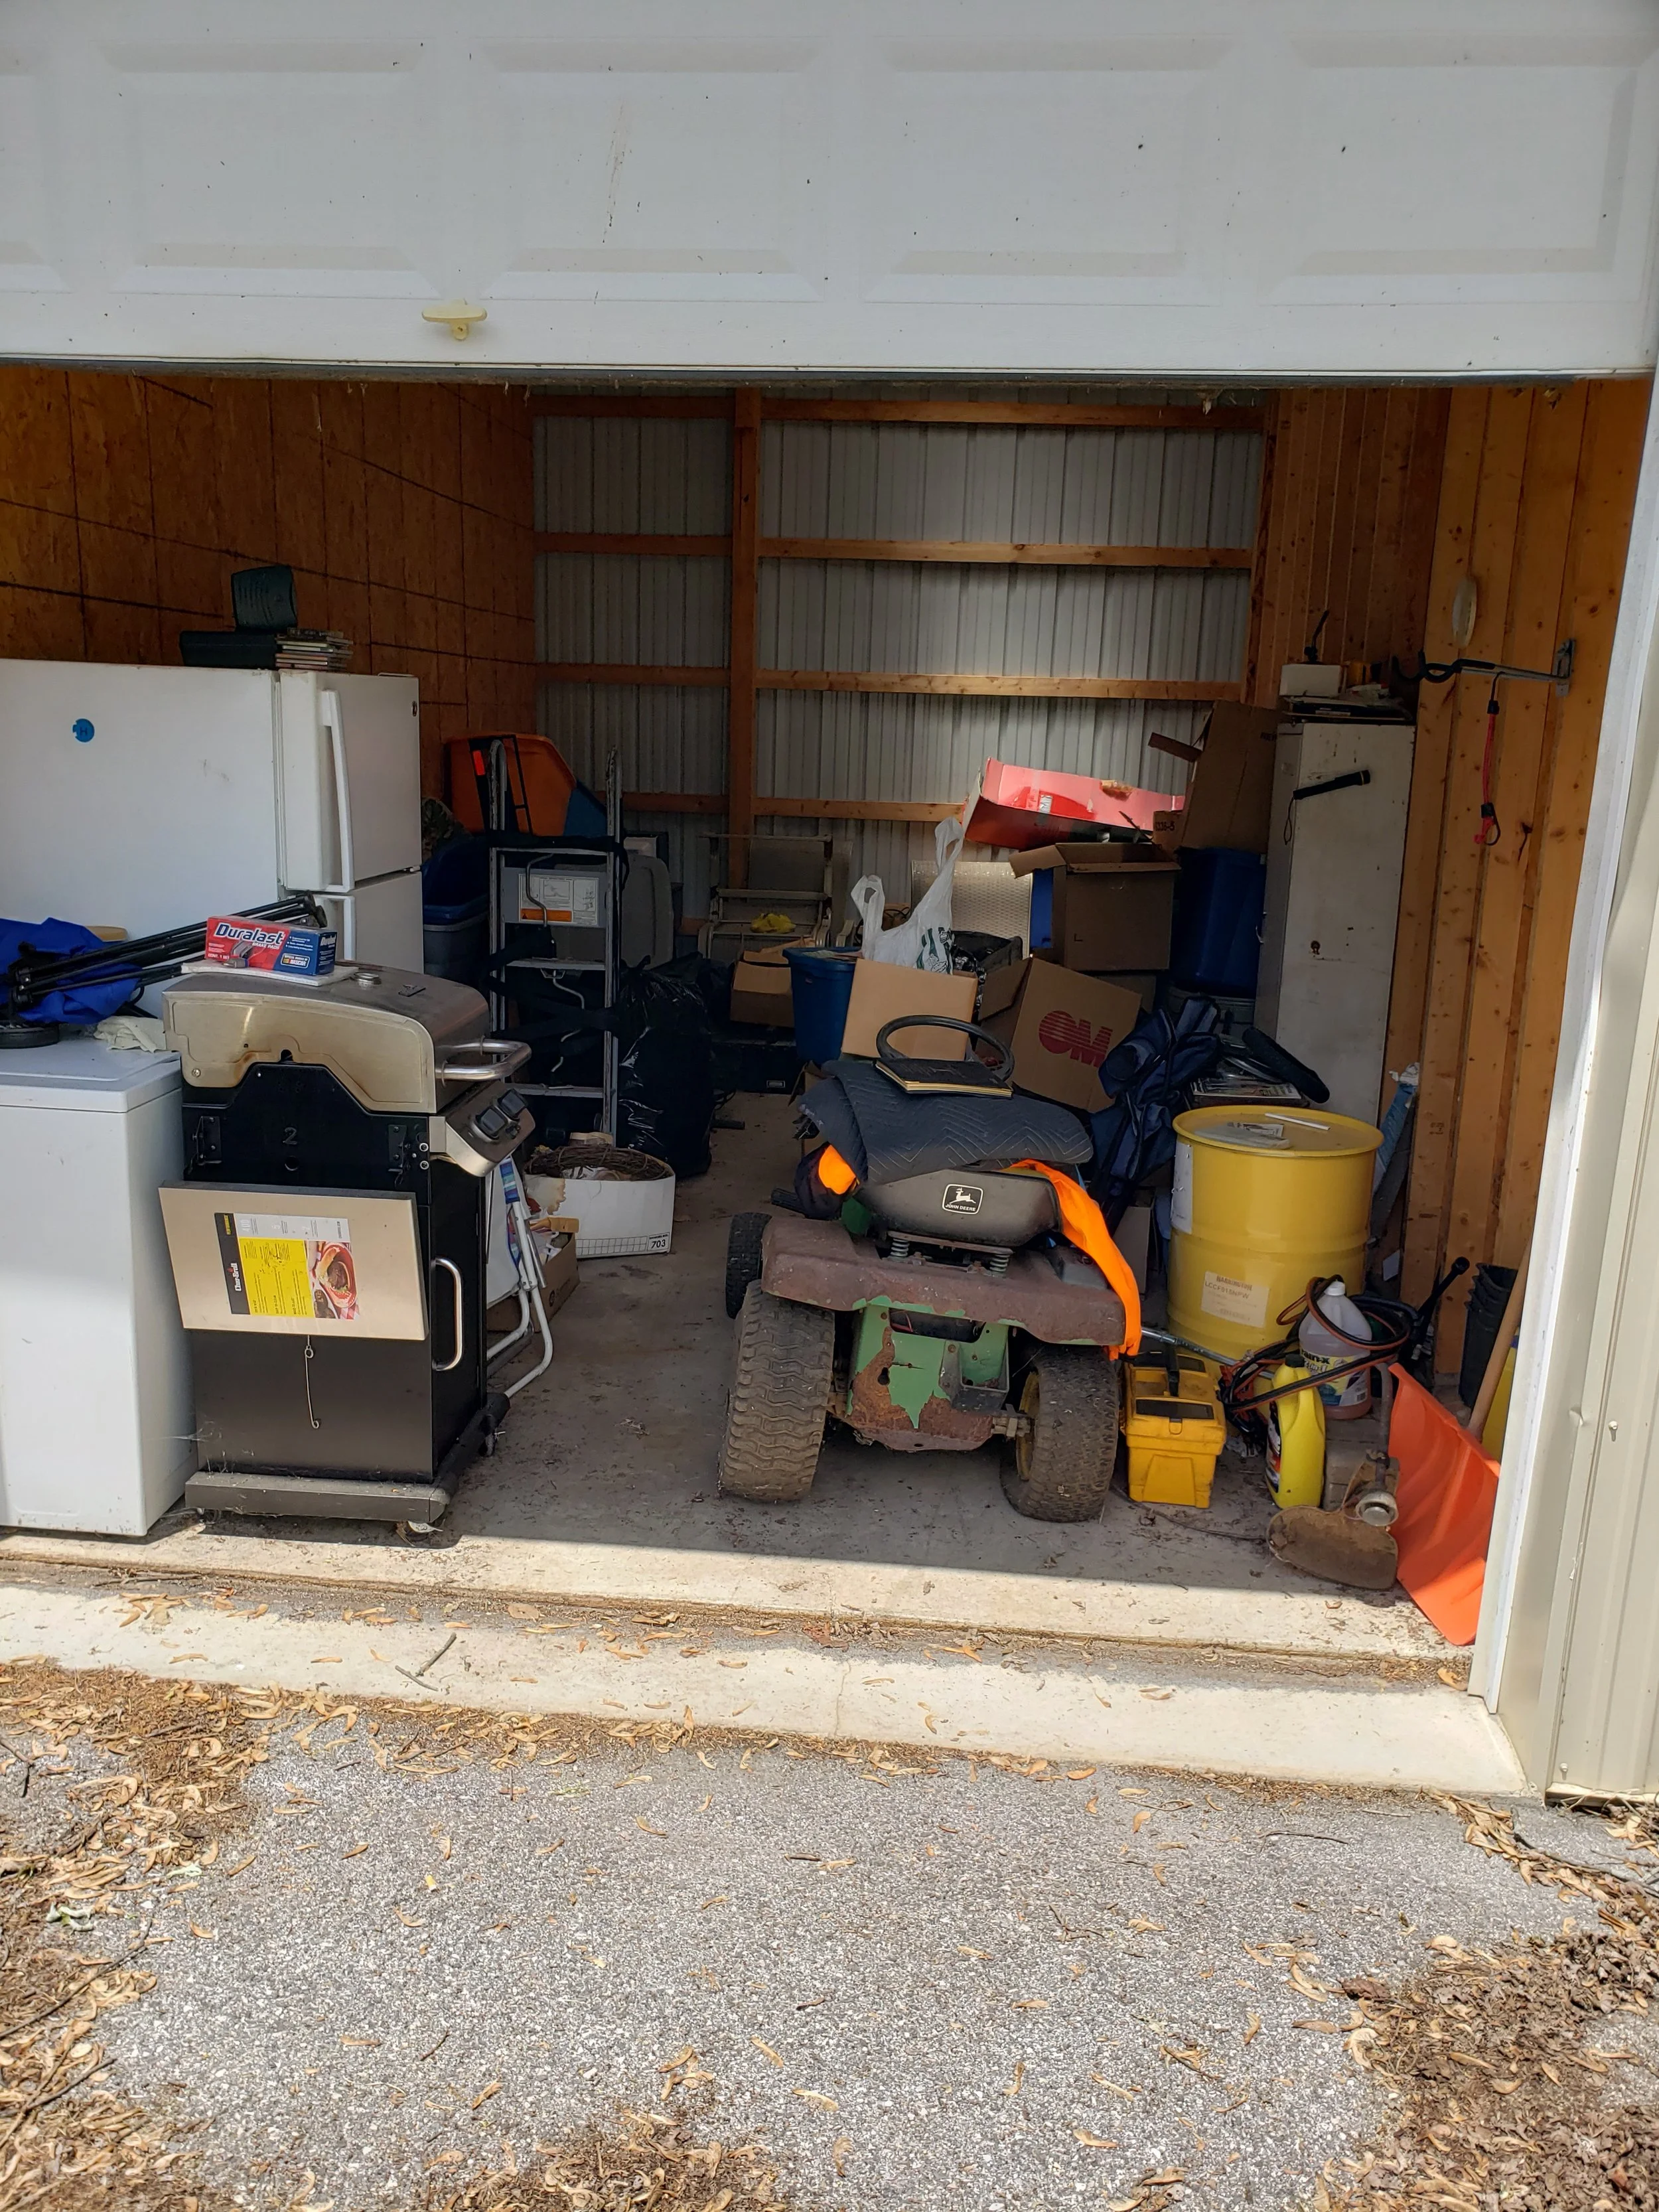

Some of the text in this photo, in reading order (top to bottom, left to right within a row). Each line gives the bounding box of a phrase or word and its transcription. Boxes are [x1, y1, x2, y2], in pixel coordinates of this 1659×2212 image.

[215, 922, 285, 945] Duralast
[284, 1127, 297, 1145] 2
[651, 1238, 666, 1249] 703
